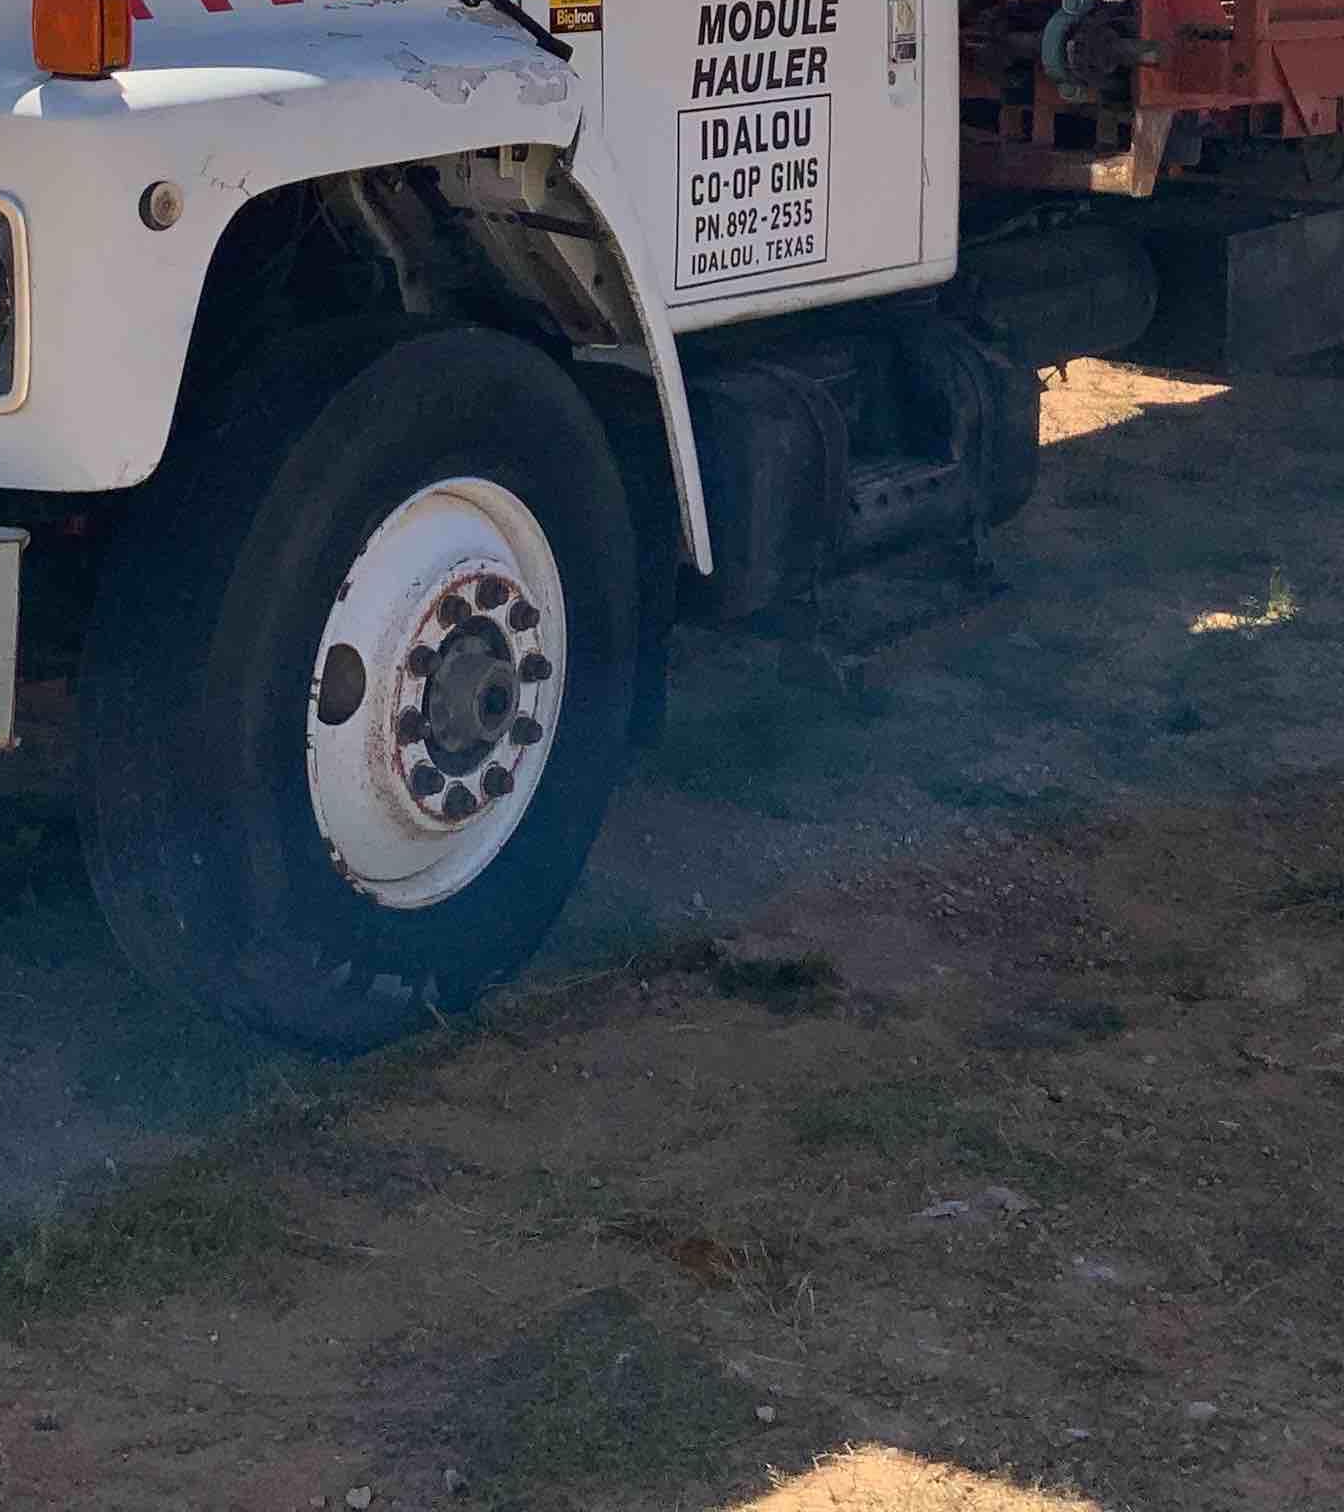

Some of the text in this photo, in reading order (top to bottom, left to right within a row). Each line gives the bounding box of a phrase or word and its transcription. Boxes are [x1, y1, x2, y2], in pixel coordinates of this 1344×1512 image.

[556, 8, 595, 29] BigIron
[691, 46, 828, 99] HAULER
[701, 107, 812, 160] IDALOU
[691, 157, 819, 206] CO-OP GINS
[766, 234, 815, 261] TEXAS
